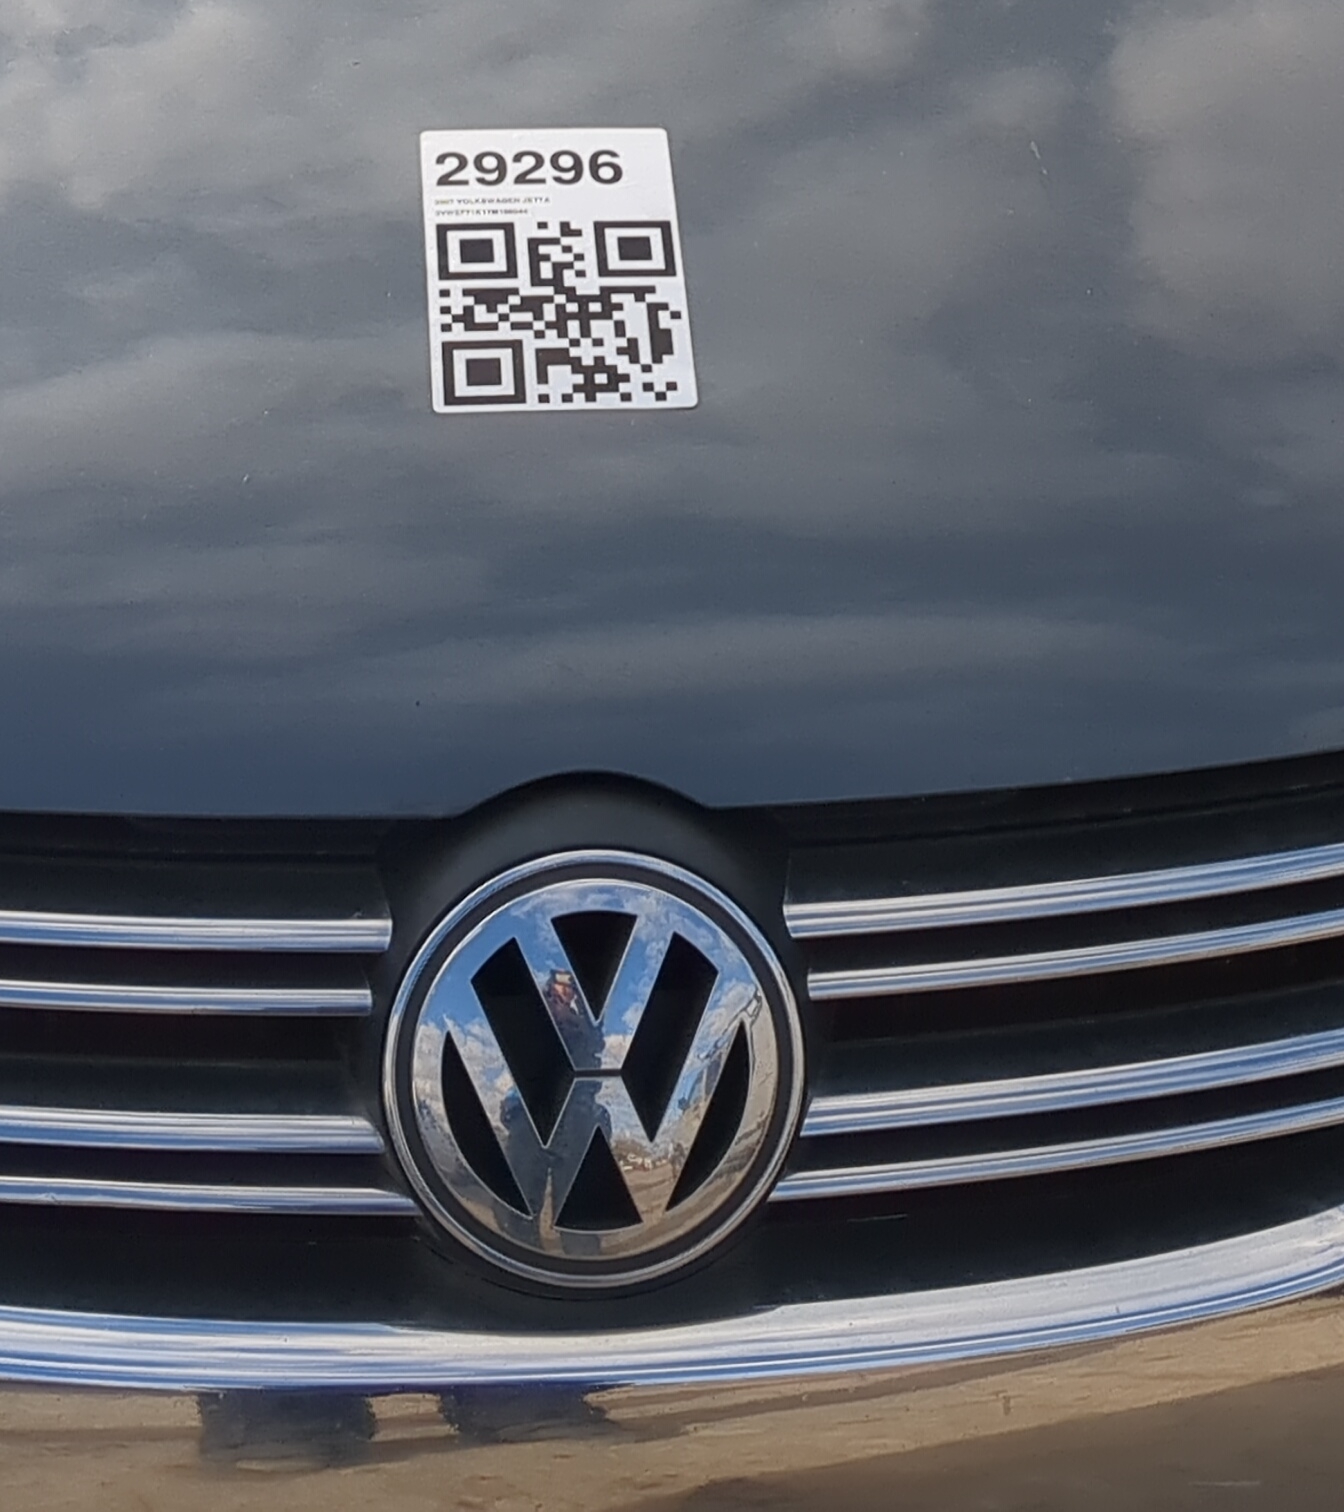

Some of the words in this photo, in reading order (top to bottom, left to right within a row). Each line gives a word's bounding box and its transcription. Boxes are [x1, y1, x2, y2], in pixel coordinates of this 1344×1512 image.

[434, 149, 624, 187] 29296
[456, 196, 521, 205] VOLKSWAGEN
[523, 196, 551, 204] JETTA
